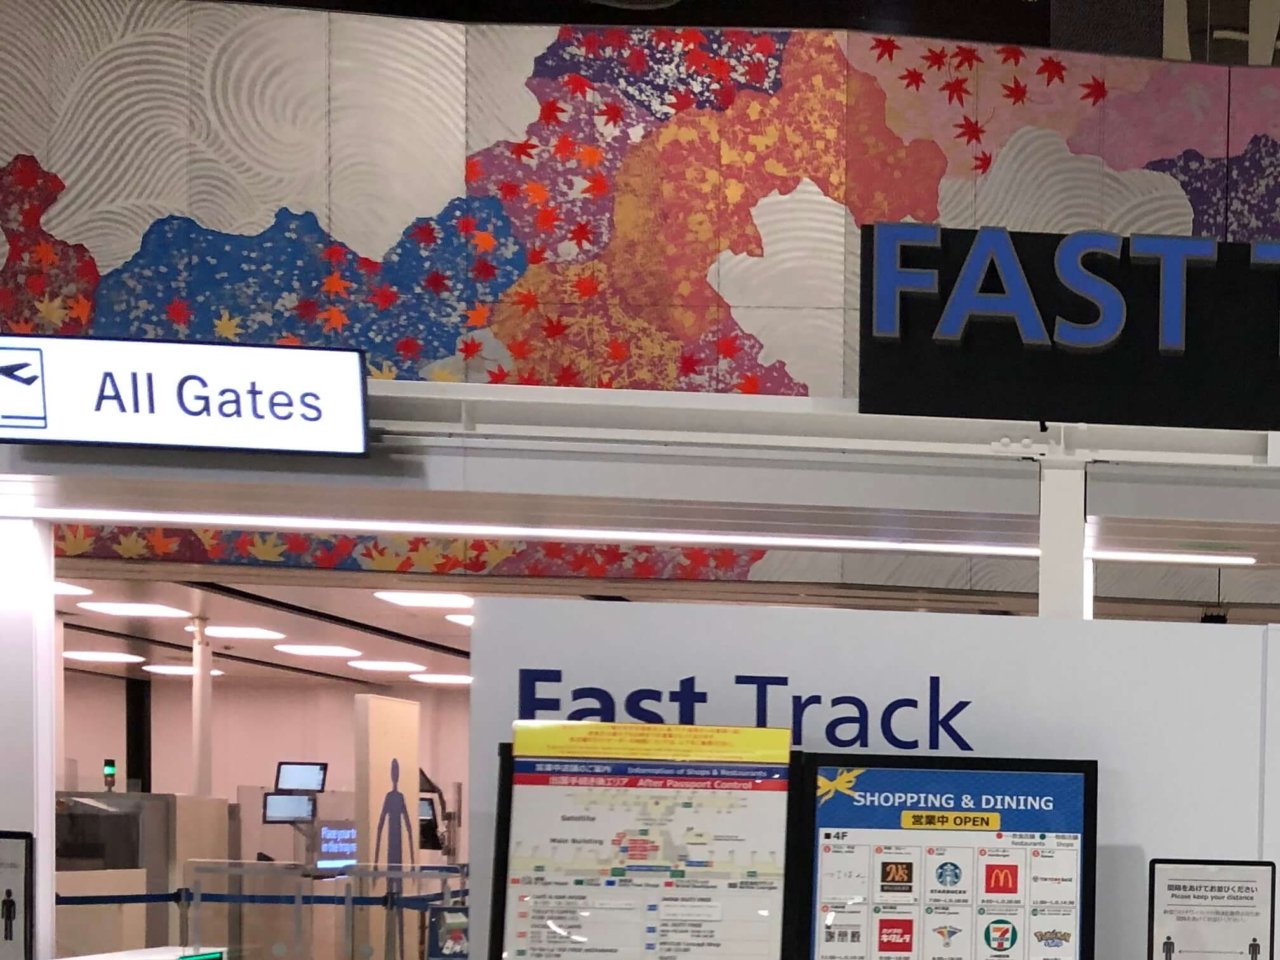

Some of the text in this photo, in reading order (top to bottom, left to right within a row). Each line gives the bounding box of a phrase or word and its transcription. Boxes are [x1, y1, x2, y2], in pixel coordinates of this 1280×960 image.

[873, 221, 1217, 352] FAST
[94, 371, 323, 423] All Gates
[735, 675, 974, 752] Track
[637, 779, 753, 790] After Passport Control
[853, 792, 1054, 810] SHOPPING & DINING
[953, 816, 990, 827] OPEN
[832, 832, 848, 840] 4F
